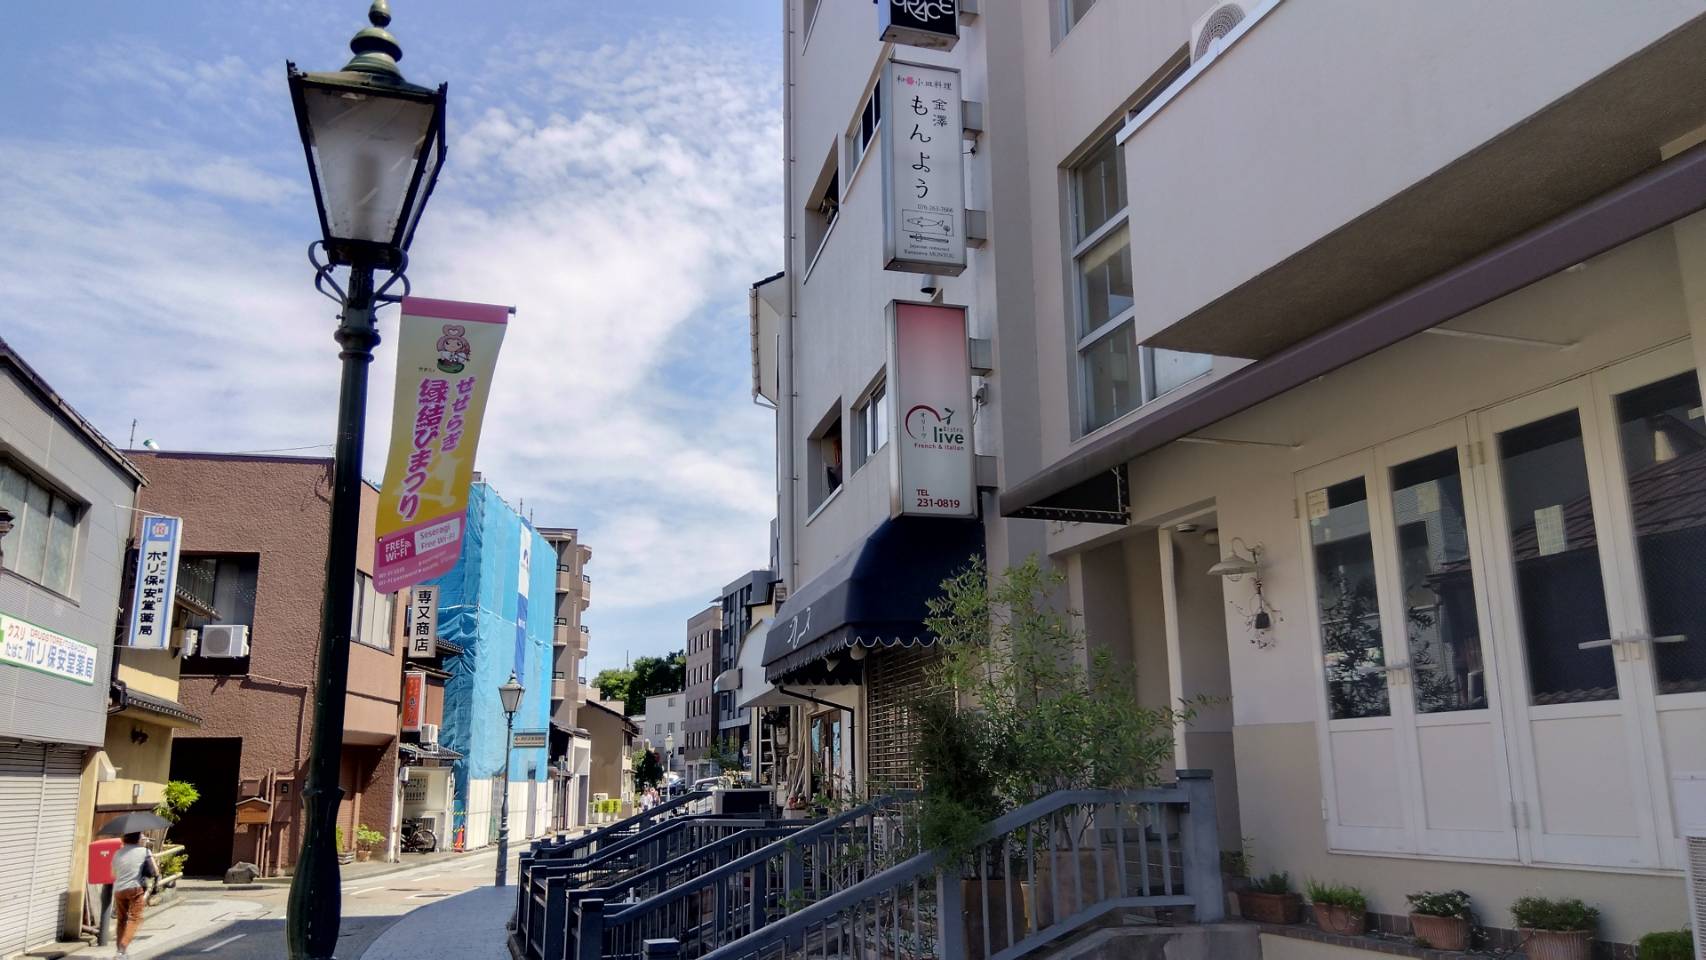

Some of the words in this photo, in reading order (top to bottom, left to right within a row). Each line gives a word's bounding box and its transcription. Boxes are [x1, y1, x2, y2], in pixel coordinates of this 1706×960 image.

[932, 99, 948, 127] 金澤
[910, 95, 932, 199] もんよう
[440, 376, 476, 453] せせらぎ
[398, 377, 449, 521] 縁結びまつり
[917, 489, 930, 497] TEL
[917, 498, 960, 508] 231-0819
[385, 538, 406, 553] FREE
[138, 551, 161, 636] ホリ保安堂薬局
[8, 624, 26, 640] クスリ
[6, 642, 23, 659] たばこ
[25, 640, 94, 679] ホリ保安堂薬局
